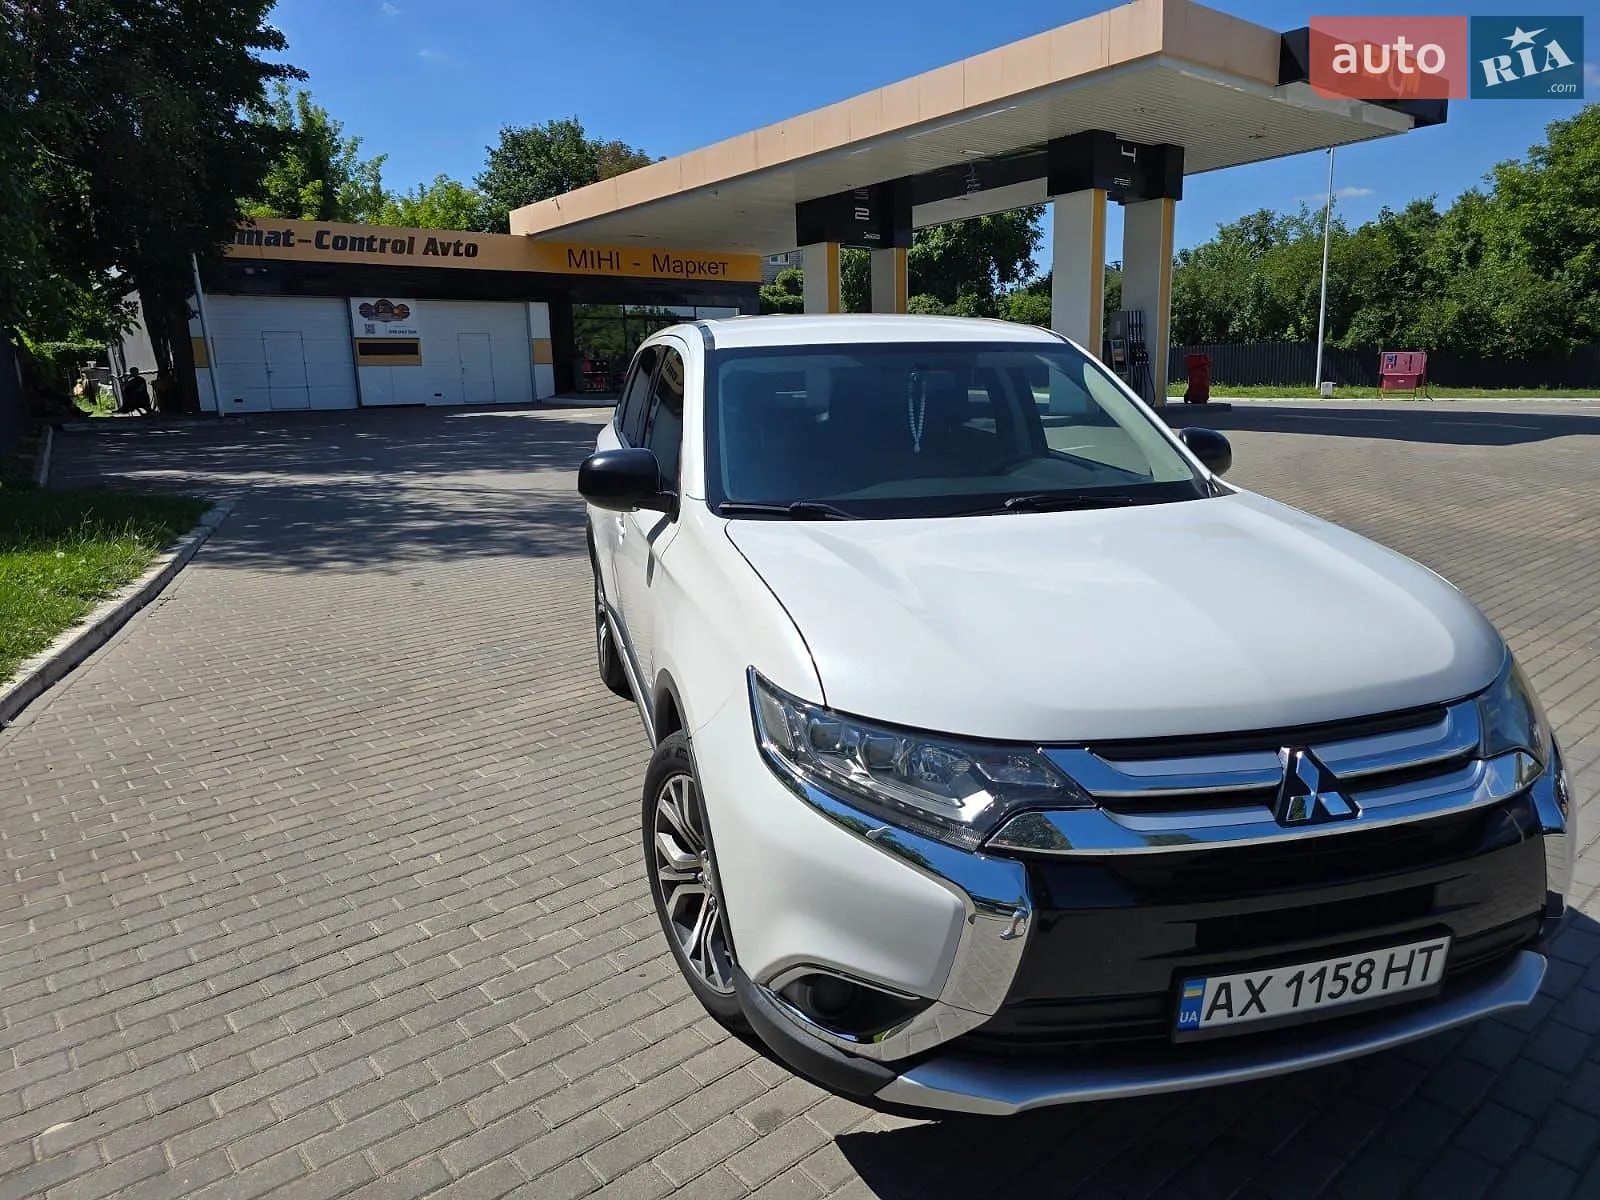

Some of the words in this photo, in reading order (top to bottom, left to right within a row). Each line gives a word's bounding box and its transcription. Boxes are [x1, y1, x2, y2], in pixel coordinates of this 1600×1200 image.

[236, 228, 415, 255] mat-Control
[422, 236, 479, 258] Avto
[567, 248, 620, 271] МІНІ
[652, 253, 729, 278] Маркет
[1285, 958, 1376, 1008] 1158
[1179, 1010, 1199, 1025] UA
